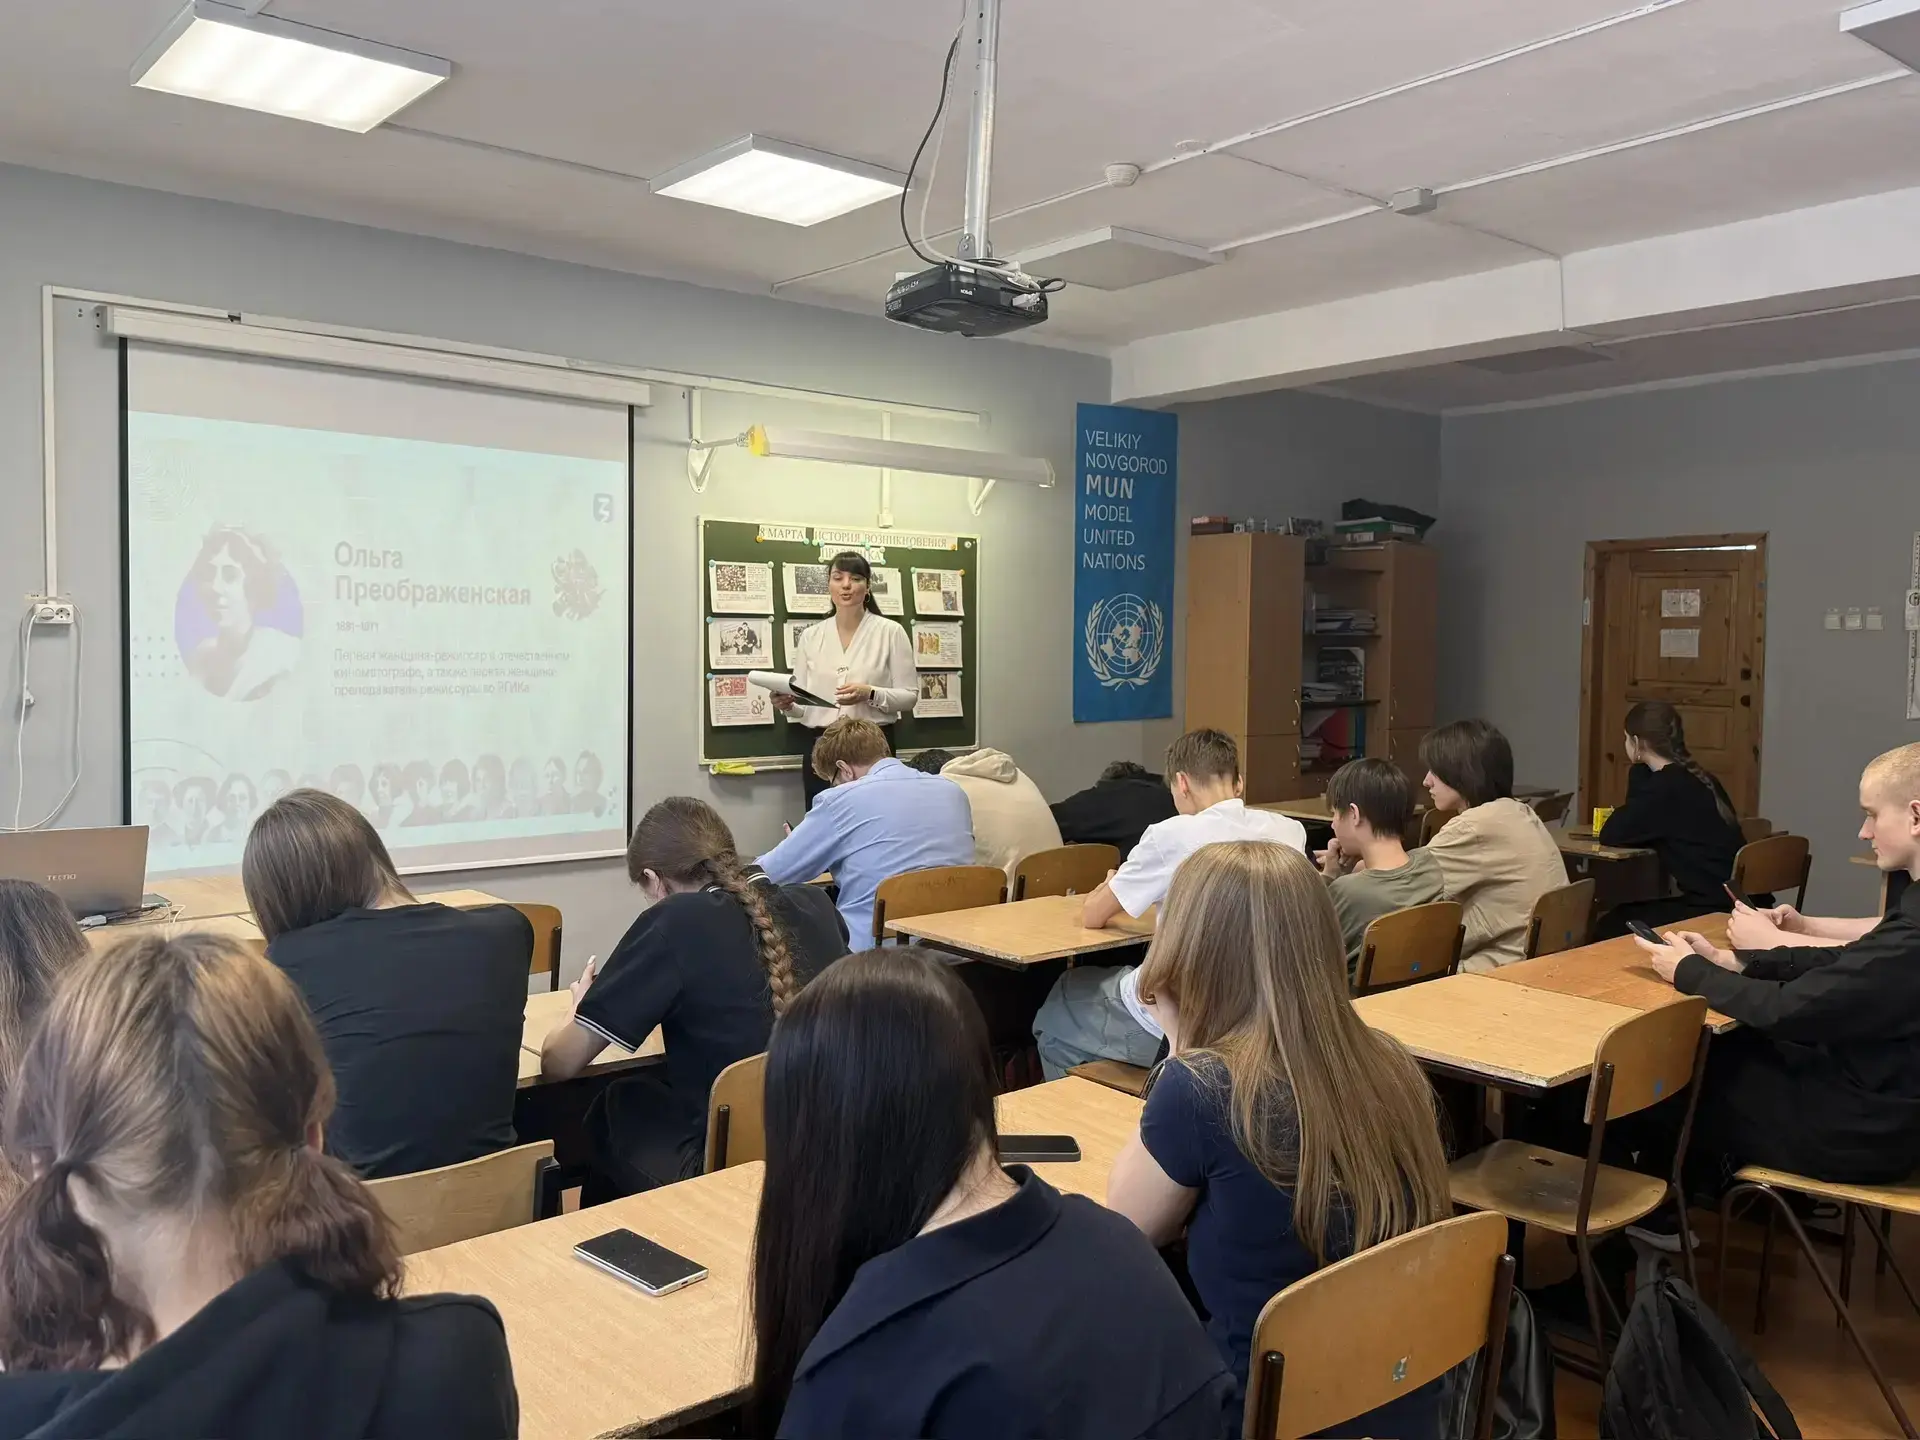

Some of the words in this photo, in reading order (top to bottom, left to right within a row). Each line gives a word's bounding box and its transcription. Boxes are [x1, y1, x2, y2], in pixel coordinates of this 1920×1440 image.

[1085, 429, 1142, 450] VELIKIY
[1085, 452, 1168, 476] NOVGOROD
[1085, 474, 1134, 499] MUN
[1084, 504, 1133, 523] MODEL
[768, 528, 804, 540] МАРТА
[814, 530, 860, 543] ИСТОРИЯ
[864, 533, 947, 548] ВОЗНИКНОВЕНИЯ
[1083, 528, 1135, 546] UNITED
[333, 540, 403, 568] Ольга
[1083, 552, 1146, 571] NATIONS
[334, 574, 532, 607] Преображенская
